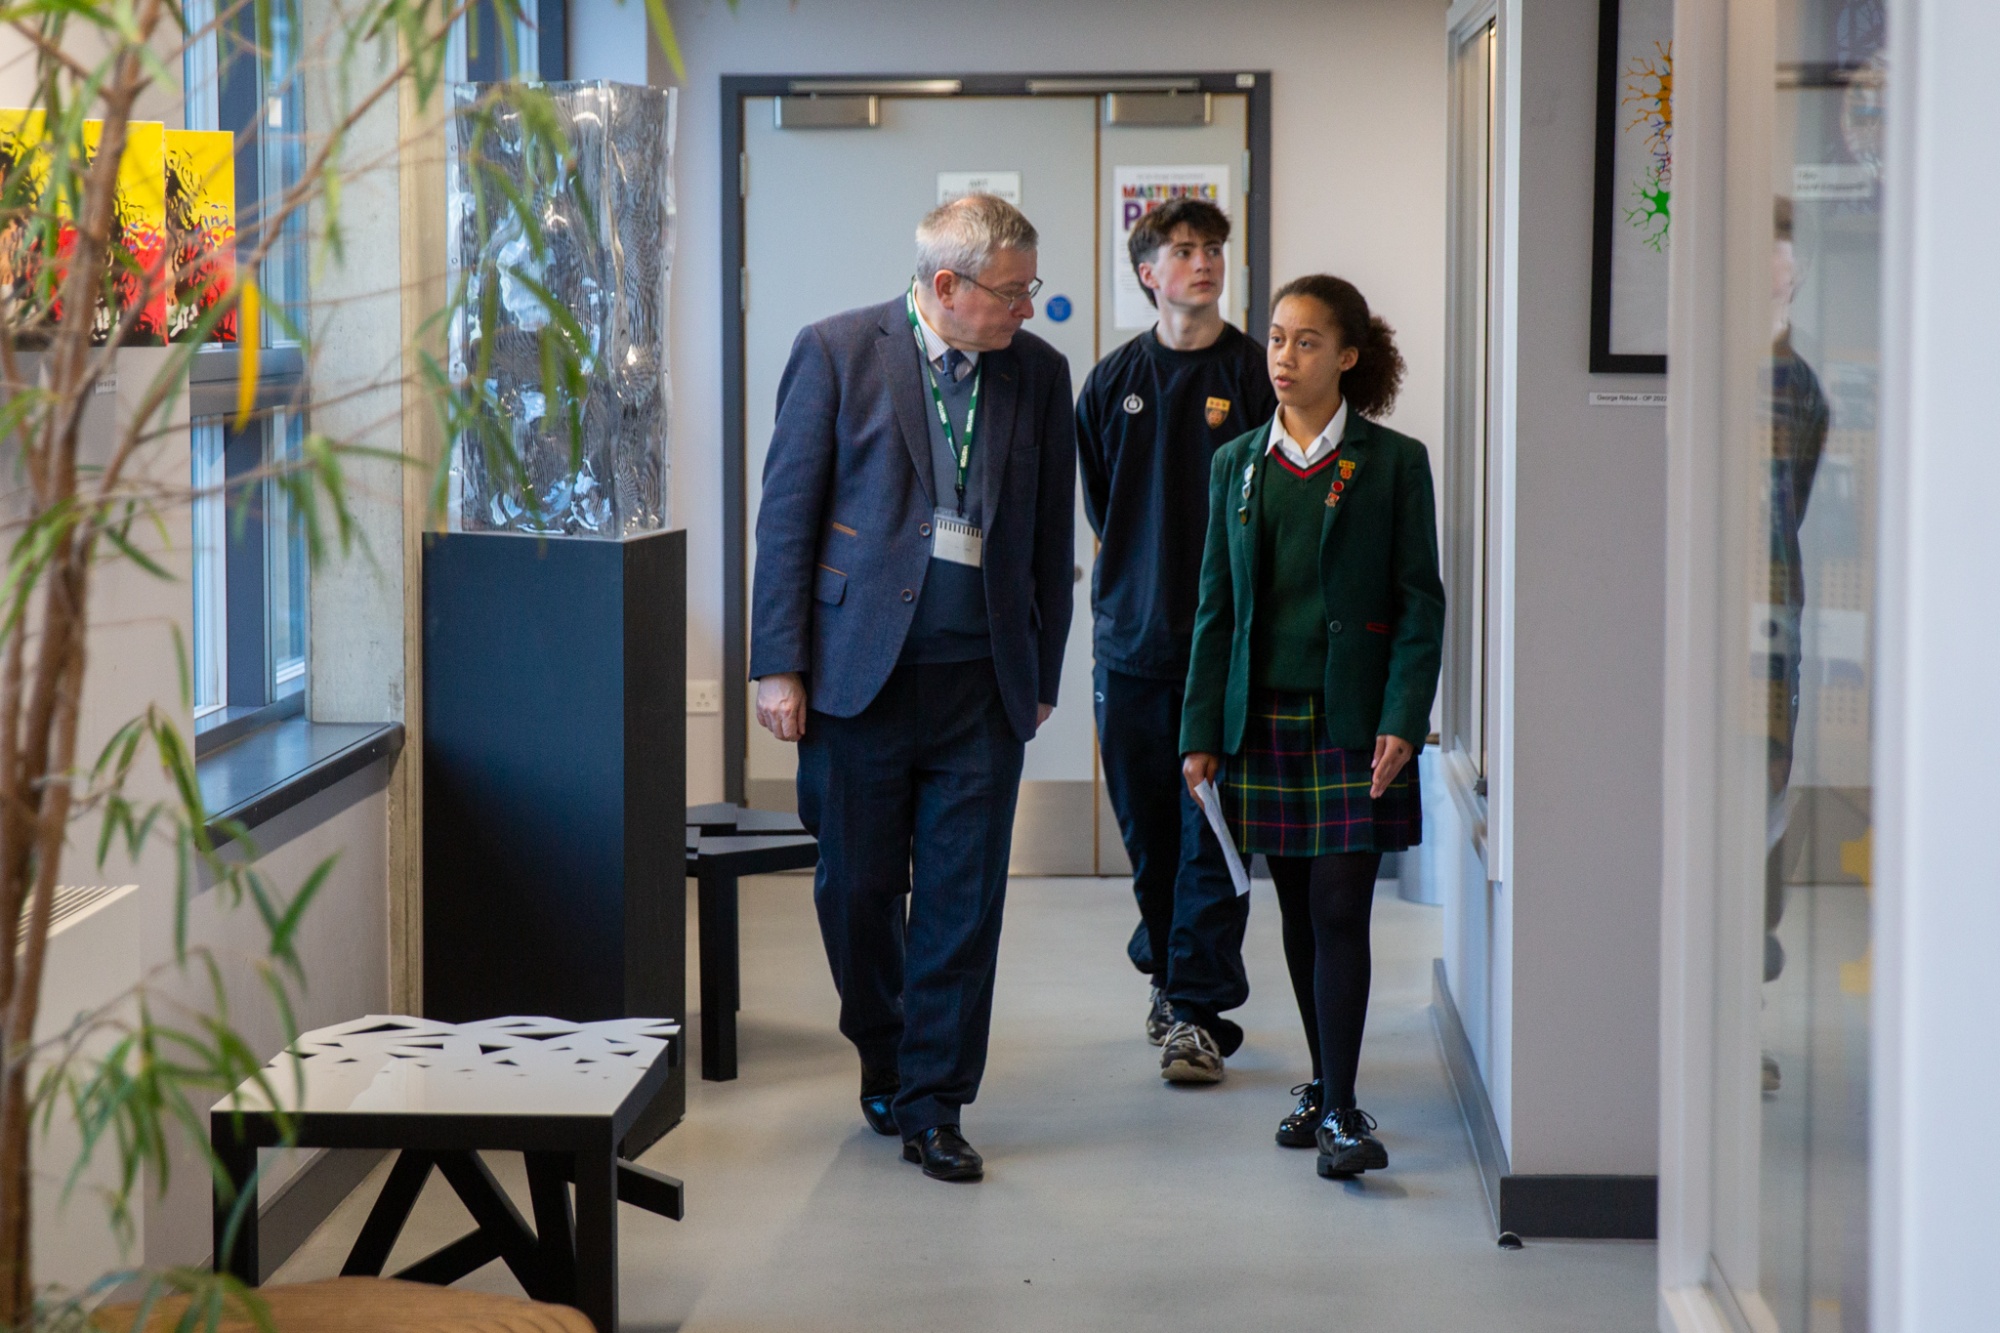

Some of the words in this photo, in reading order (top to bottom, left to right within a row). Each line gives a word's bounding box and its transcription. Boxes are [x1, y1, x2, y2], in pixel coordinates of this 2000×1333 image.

[1122, 183, 1217, 199] MASTERPIECE
[965, 408, 975, 433] VISITOR
[960, 444, 970, 469] VISITOR
